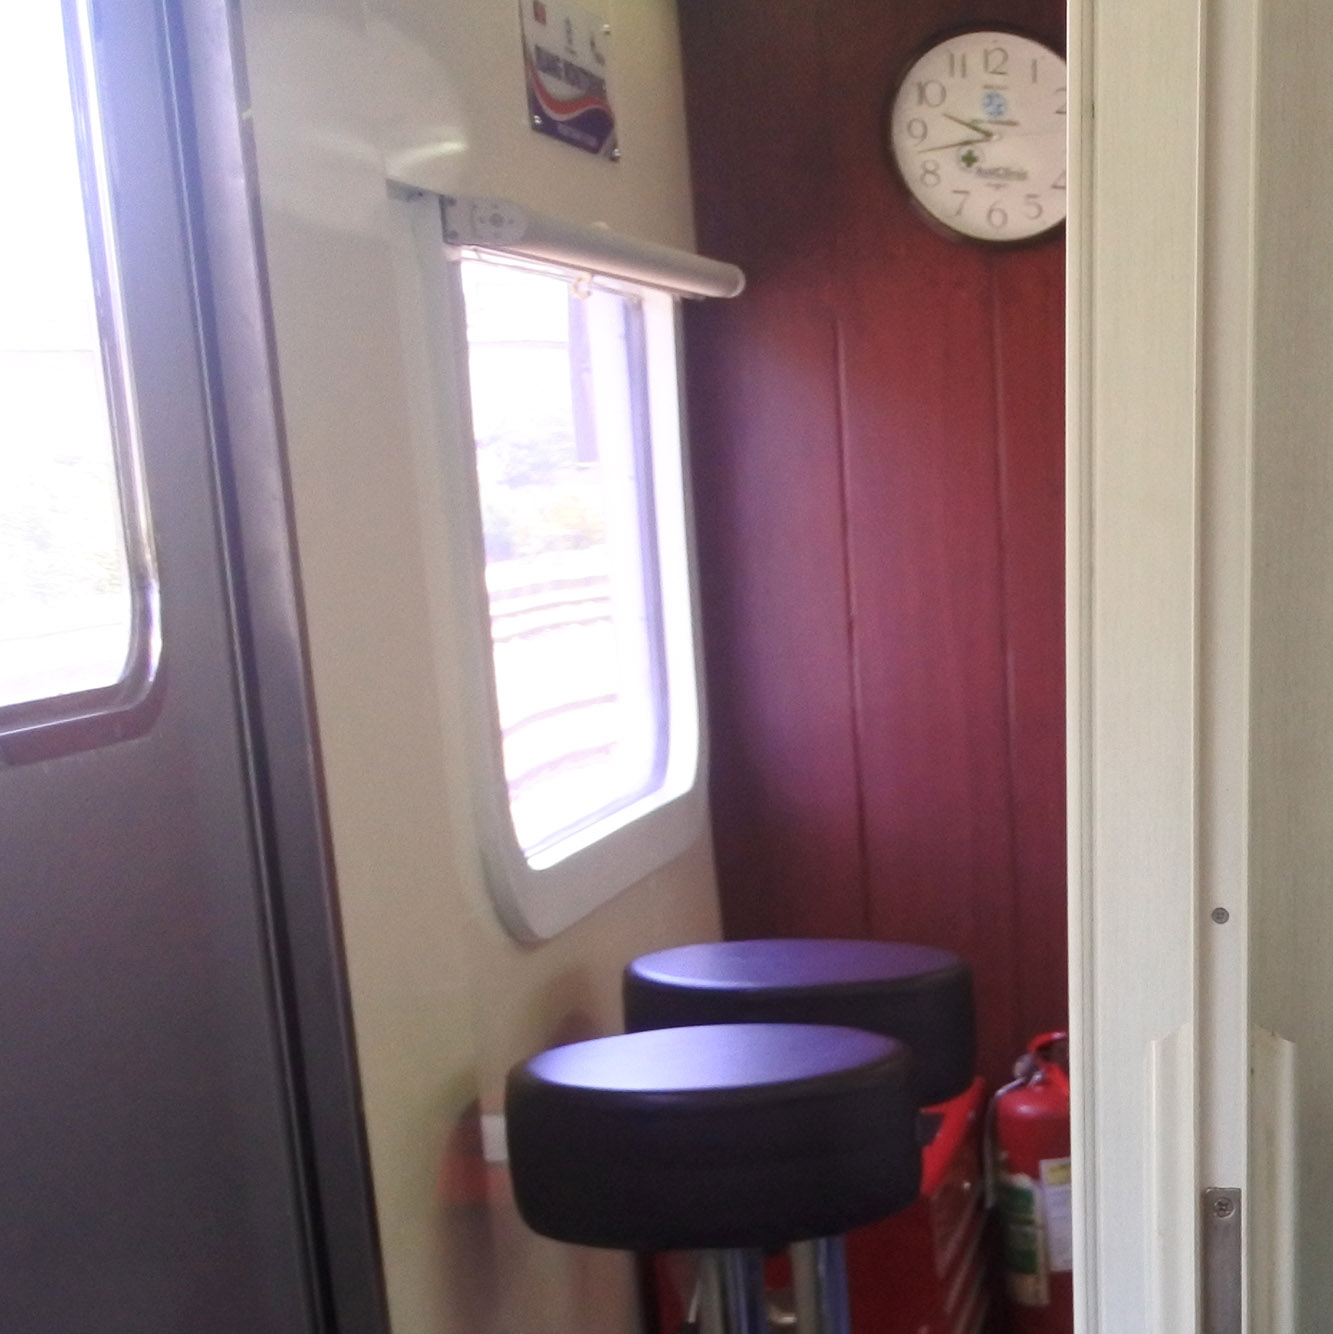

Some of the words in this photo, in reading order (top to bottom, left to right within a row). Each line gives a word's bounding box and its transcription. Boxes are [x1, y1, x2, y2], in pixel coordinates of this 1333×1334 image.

[950, 52, 967, 78] 11
[984, 47, 1009, 76] 12
[1031, 58, 1038, 84] 1
[916, 80, 947, 108] 10
[907, 118, 928, 146] 9
[920, 160, 941, 187] 8
[952, 189, 970, 216] 7
[987, 201, 1008, 229] 6
[1024, 193, 1043, 220] 5
